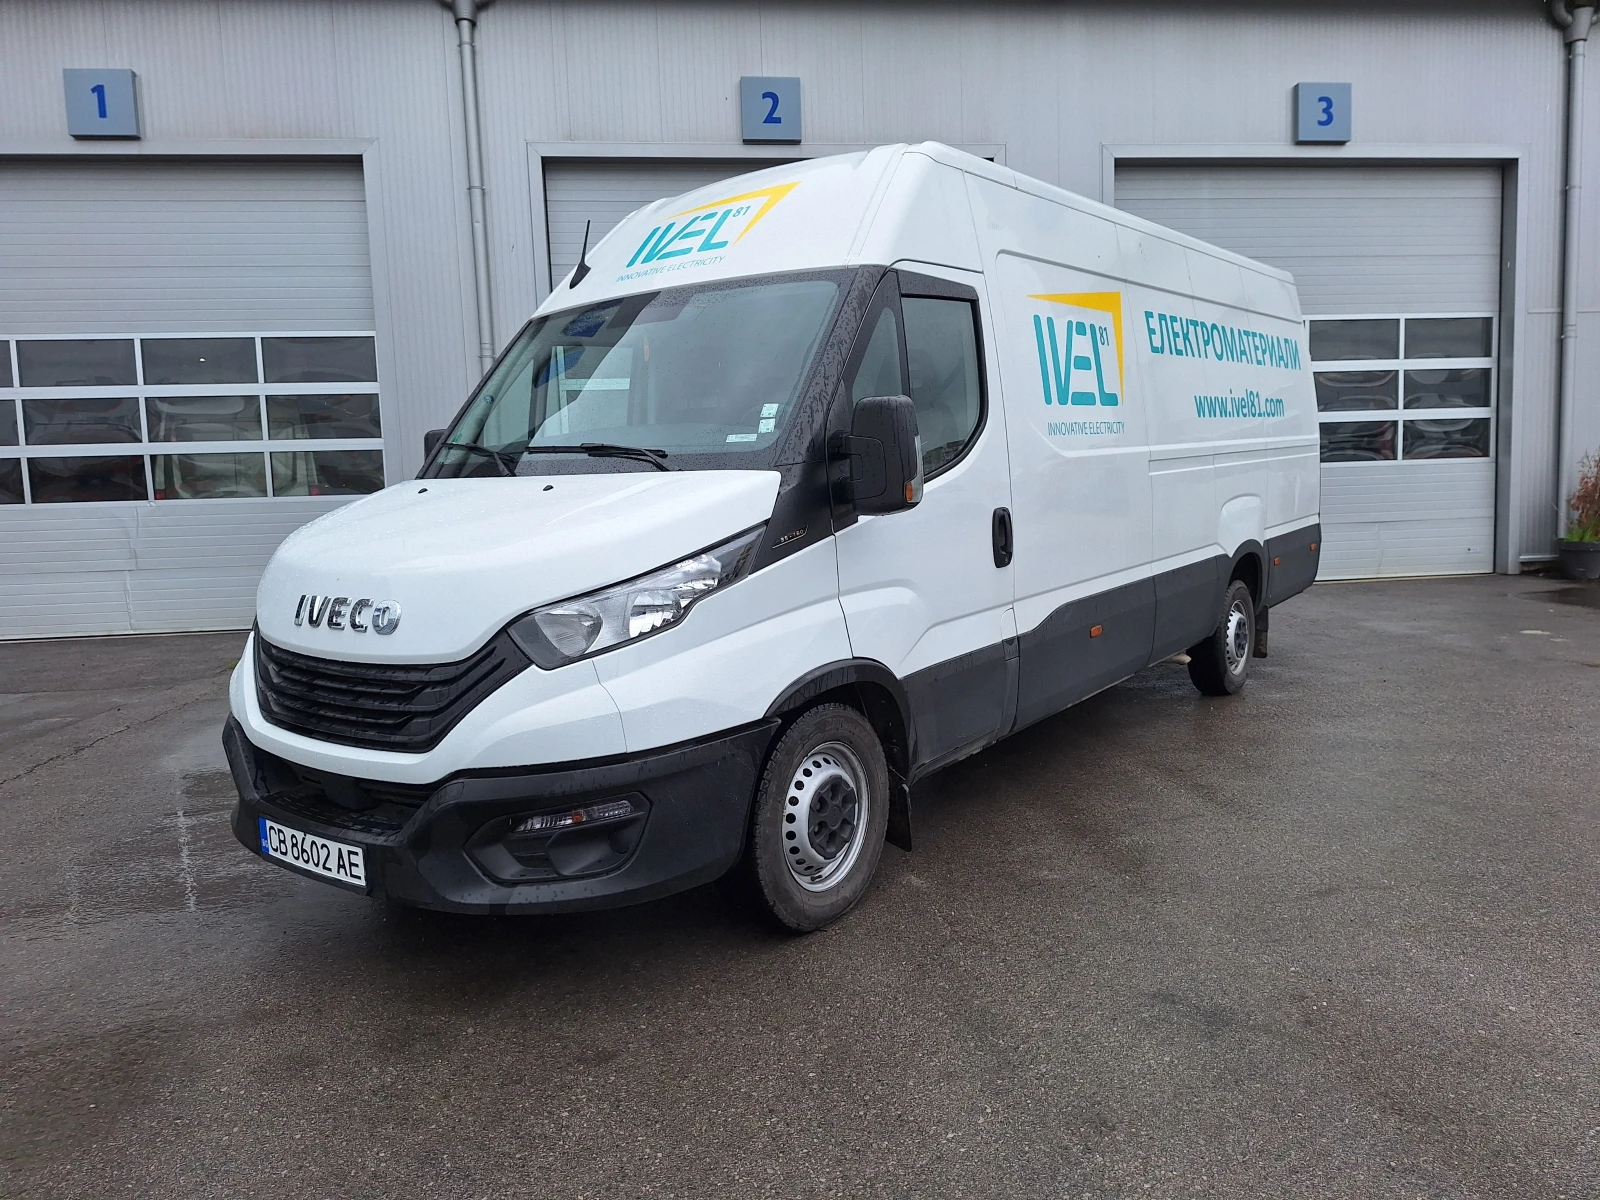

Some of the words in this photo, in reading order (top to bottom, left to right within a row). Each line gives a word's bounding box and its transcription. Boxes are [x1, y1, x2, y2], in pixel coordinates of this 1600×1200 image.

[90, 84, 107, 118] 1
[761, 91, 782, 124] 2
[1317, 96, 1334, 126] 3
[626, 208, 732, 268] IVEL
[732, 205, 751, 218] 81
[616, 265, 668, 282] INNOVATIVE
[667, 255, 726, 272] ELECTRICITY
[1144, 310, 1301, 370] ЕЛЕКТРОМАТЕРИАЛИ
[1033, 314, 1119, 406] IVEL
[1098, 325, 1110, 346] 81
[1194, 388, 1285, 418] www.ivel81.com
[1047, 421, 1088, 436] INNOVATIVE
[1088, 421, 1125, 435] ELECTRICITY
[294, 595, 402, 635] IVECO
[291, 833, 332, 872] 8602
